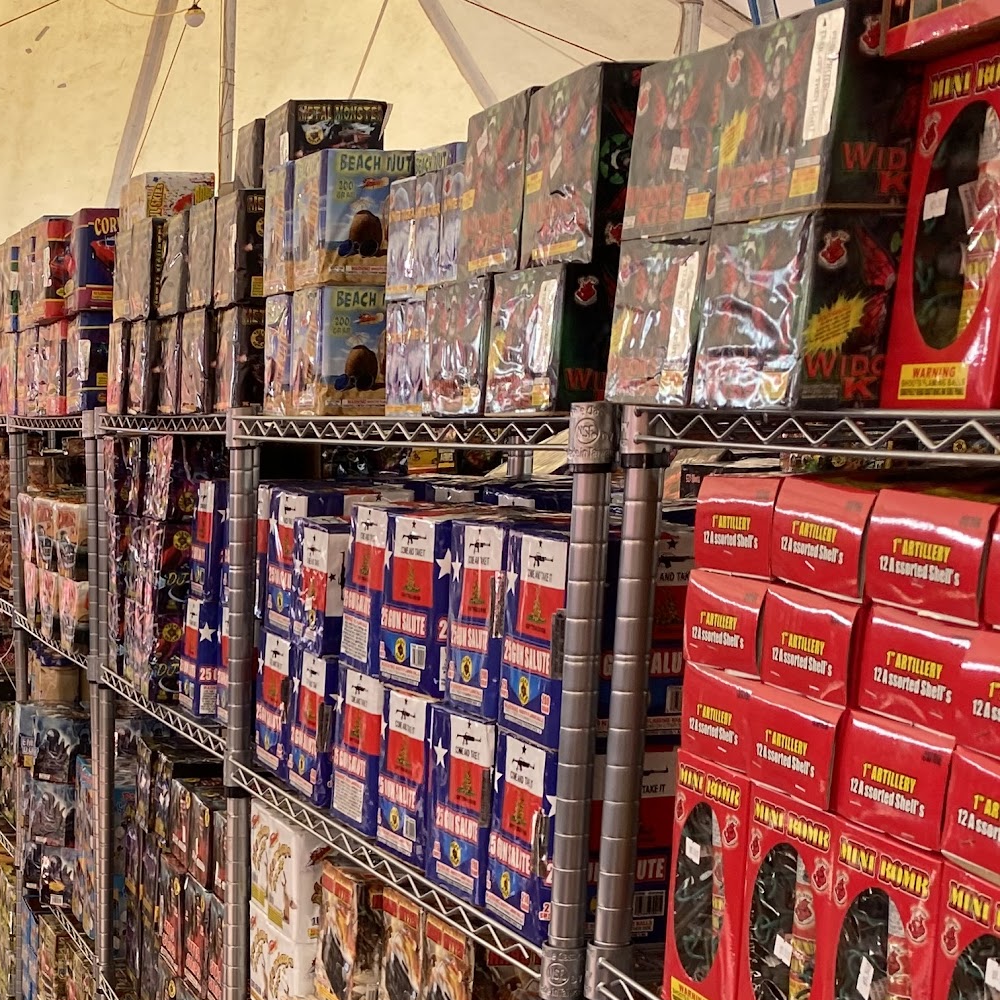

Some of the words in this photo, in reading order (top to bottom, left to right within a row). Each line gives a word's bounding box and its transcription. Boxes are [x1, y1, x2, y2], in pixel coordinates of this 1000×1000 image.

[929, 65, 973, 105] MINI
[340, 154, 381, 171] BEACH
[386, 154, 417, 172] NUT
[336, 290, 377, 307] BEACH
[912, 366, 957, 378] WARNING
[718, 515, 751, 531] ARTILLERY
[799, 521, 838, 544] ARTILLERY
[703, 531, 710, 544] 12
[780, 536, 788, 550] 12
[902, 539, 951, 563] ARTILLERY
[879, 555, 889, 572] 12
[388, 609, 402, 632] GUN
[401, 612, 426, 637] SALUTE
[706, 612, 738, 631] ARTILLERY
[691, 625, 698, 638] 12
[772, 646, 779, 661] 12
[788, 632, 825, 657] ARTILLERY
[512, 641, 524, 664] GUN
[523, 645, 551, 676] SALUTE
[895, 652, 943, 680] ARTILLERY
[873, 666, 882, 682] 12
[702, 704, 733, 727] ARTILLERY
[972, 699, 984, 716] 12
[689, 717, 695, 730] 12
[756, 742, 764, 757] 12
[772, 731, 808, 756] ARTILLERY
[679, 762, 705, 796] MINI
[705, 774, 741, 811] BOMB
[850, 777, 858, 794] 12
[871, 765, 917, 794] ARTILLERY
[753, 797, 786, 834] MINI
[787, 811, 831, 853] BOMB
[957, 808, 968, 827] 12
[454, 813, 479, 843] SALUTE
[838, 836, 878, 879] MINI
[877, 854, 931, 901] BOMB
[947, 880, 993, 929] MINI
